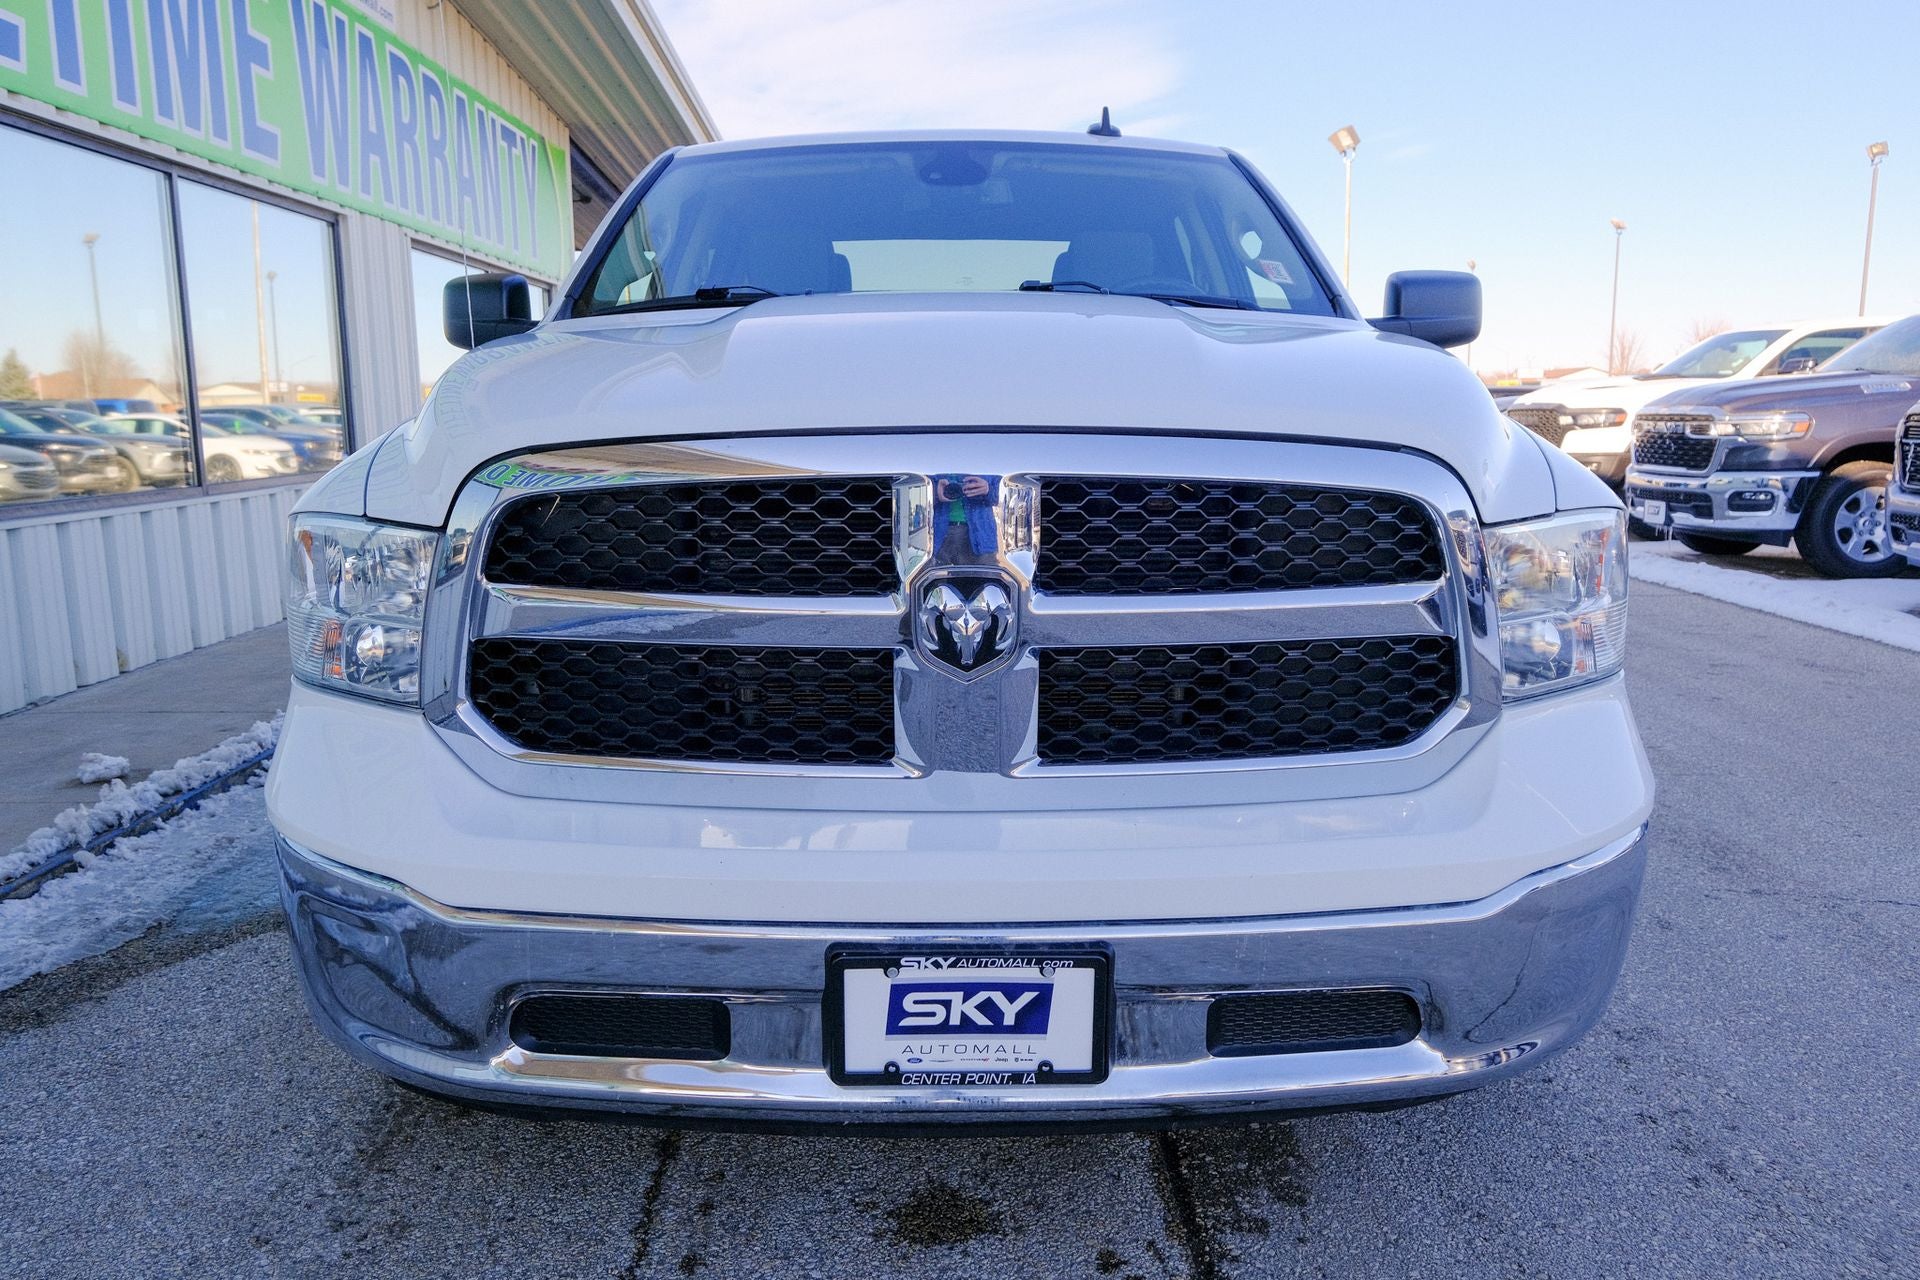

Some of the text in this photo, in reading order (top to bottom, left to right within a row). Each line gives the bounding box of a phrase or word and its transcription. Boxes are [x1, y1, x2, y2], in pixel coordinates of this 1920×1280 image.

[288, 0, 540, 263] WARRANTY
[900, 957, 1074, 970] SKY AUTOMALL.com
[898, 991, 1040, 1026] SKY
[902, 1044, 1037, 1054] AUTOMALL
[901, 1073, 1037, 1085] CENTER POINT, IA
